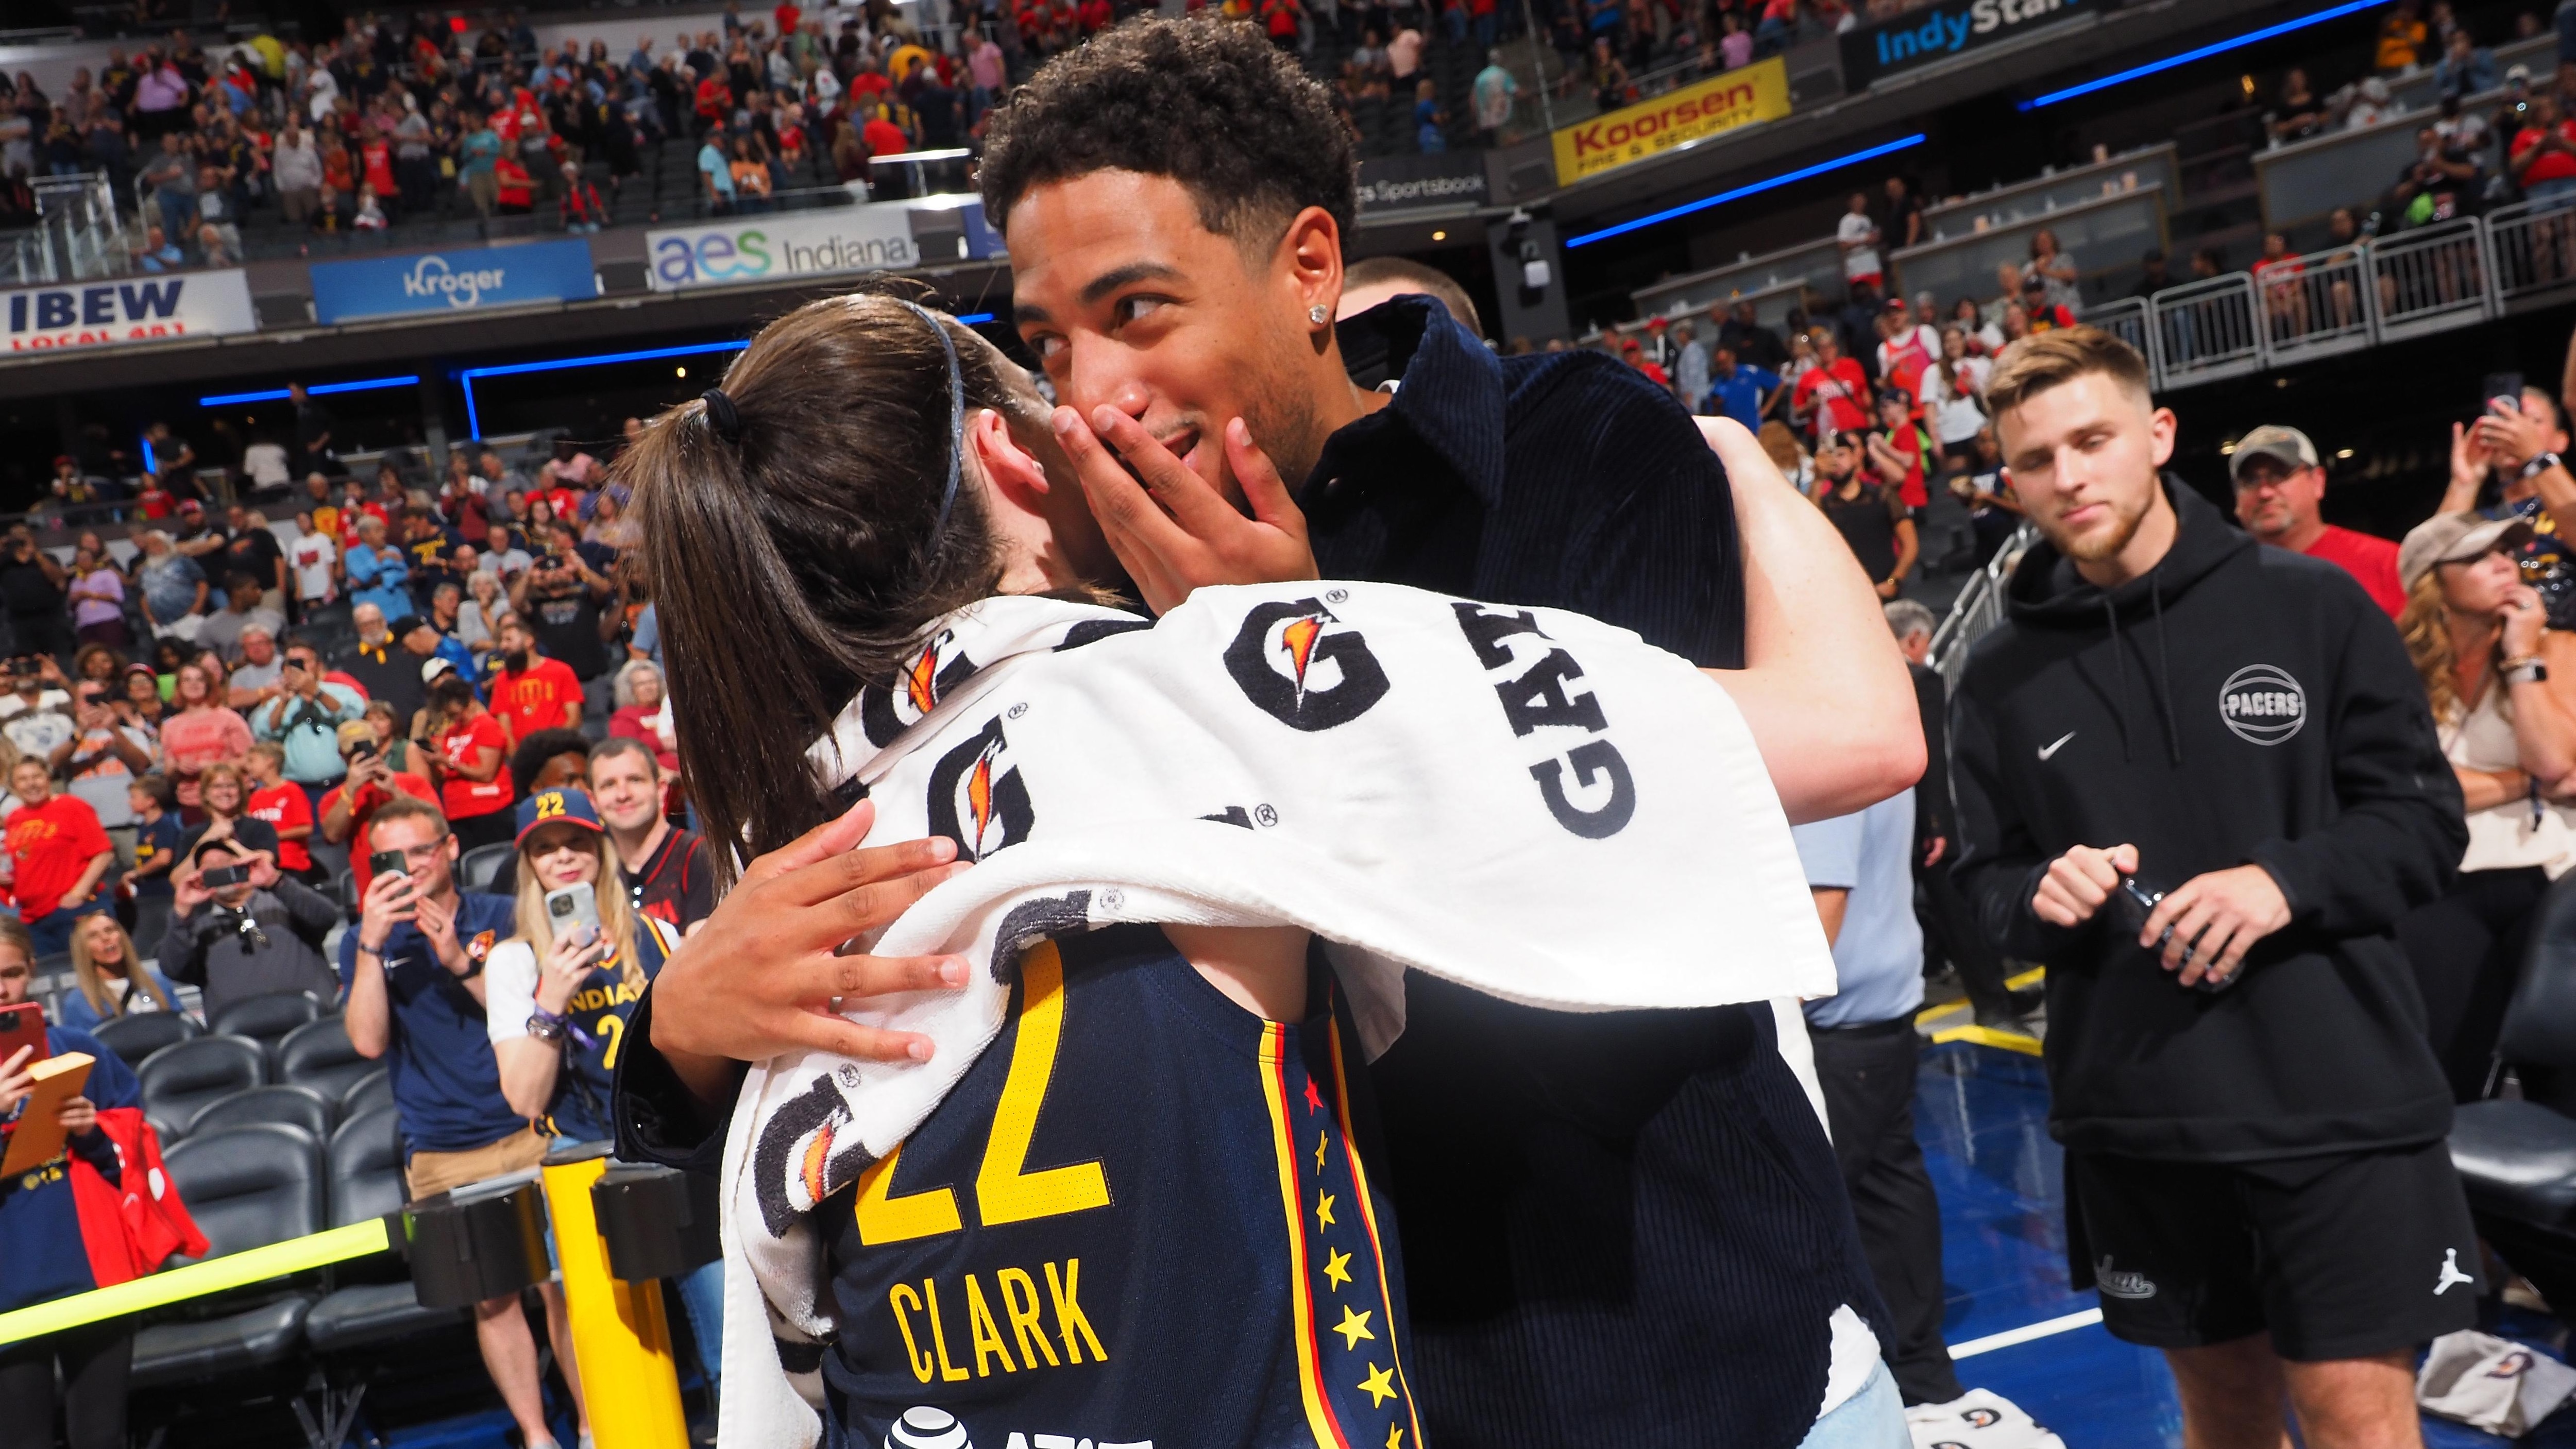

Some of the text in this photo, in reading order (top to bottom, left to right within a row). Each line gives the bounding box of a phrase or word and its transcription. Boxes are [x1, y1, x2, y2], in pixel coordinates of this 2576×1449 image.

[1573, 81, 1754, 157] Koorsen
[1375, 174, 1485, 202] Sportsbook
[402, 254, 506, 310] Kroger
[657, 229, 910, 284] aes Indiana
[10, 280, 184, 333] IBEW
[2227, 691, 2300, 718] PACERS
[535, 791, 566, 820] 22
[889, 1257, 1108, 1384] CLARK
